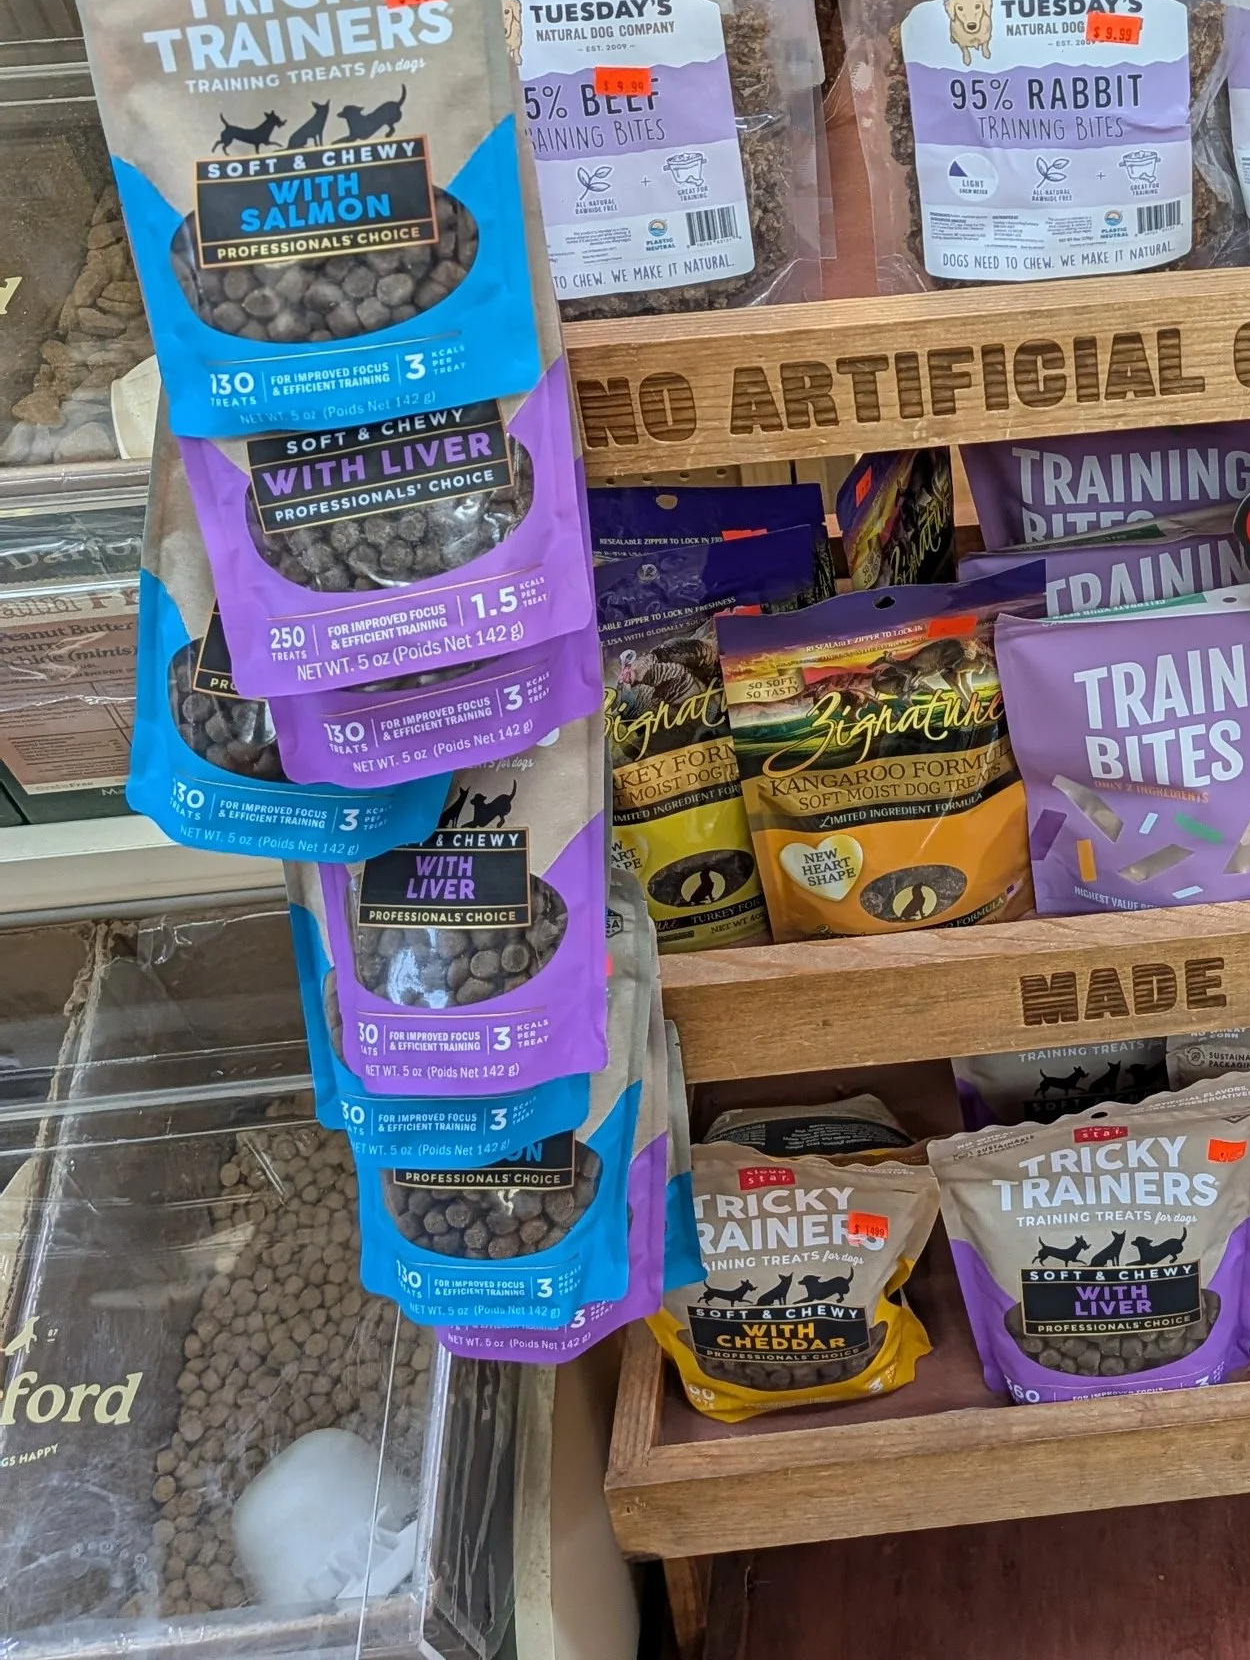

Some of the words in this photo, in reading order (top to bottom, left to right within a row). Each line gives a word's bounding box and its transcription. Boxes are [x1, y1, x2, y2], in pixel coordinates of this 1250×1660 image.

[144, 0, 454, 73] TRAINERS
[185, 71, 280, 96] TRAINING
[286, 62, 367, 84] TREATS
[207, 157, 278, 179] SOFT
[293, 156, 309, 171] &
[322, 142, 417, 167] CHEWY
[269, 173, 359, 205] WITH
[241, 193, 391, 233] SALMON
[357, 225, 421, 245] CHOICE
[577, 371, 697, 448] NO
[729, 328, 1205, 436] ARTIFICIAL
[263, 457, 366, 498] WITH
[381, 433, 493, 476] LIVER
[428, 469, 495, 494] CHOICE
[270, 626, 306, 650] 250
[471, 586, 519, 621] 1.5
[1085, 719, 1244, 788] BITES
[770, 763, 906, 797] KANGAROO
[798, 791, 840, 811] SOFT
[846, 784, 900, 806] MOIST
[905, 781, 941, 797] DOG
[944, 766, 1002, 795] TREATS
[801, 857, 851, 876] HEART
[804, 848, 838, 865] NEW
[807, 867, 857, 887] SHAPE
[1019, 956, 1227, 1027] MADE
[1019, 1136, 1189, 1178] TRICKY
[992, 1171, 1218, 1213] TRAINERS
[1073, 1297, 1153, 1317] LIVER
[1076, 1282, 1149, 1301] WITH
[716, 1334, 847, 1352] CHEDDAR
[742, 1321, 815, 1341] WITH
[19, 1443, 59, 1464] HAPPY
